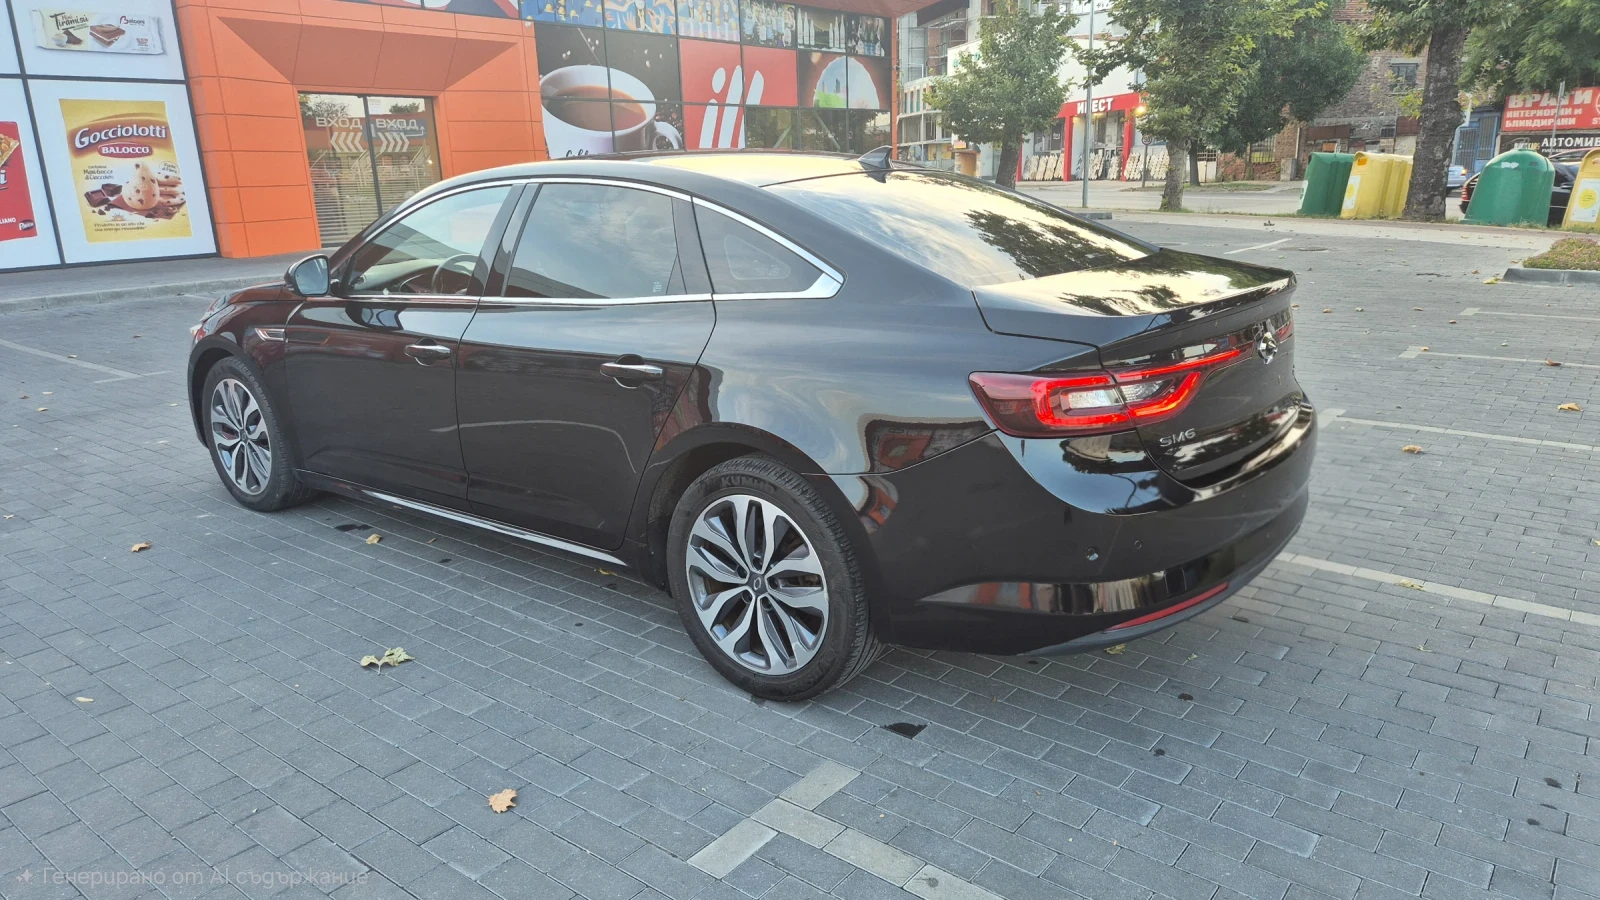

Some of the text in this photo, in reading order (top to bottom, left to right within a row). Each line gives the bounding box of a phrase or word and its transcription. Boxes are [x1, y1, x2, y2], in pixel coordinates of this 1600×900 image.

[316, 117, 363, 129] ВХОД
[375, 118, 419, 130] ВХОД
[75, 124, 166, 149] Gocciolotti
[101, 146, 150, 154] BALOCCO
[1159, 428, 1196, 447] SM6
